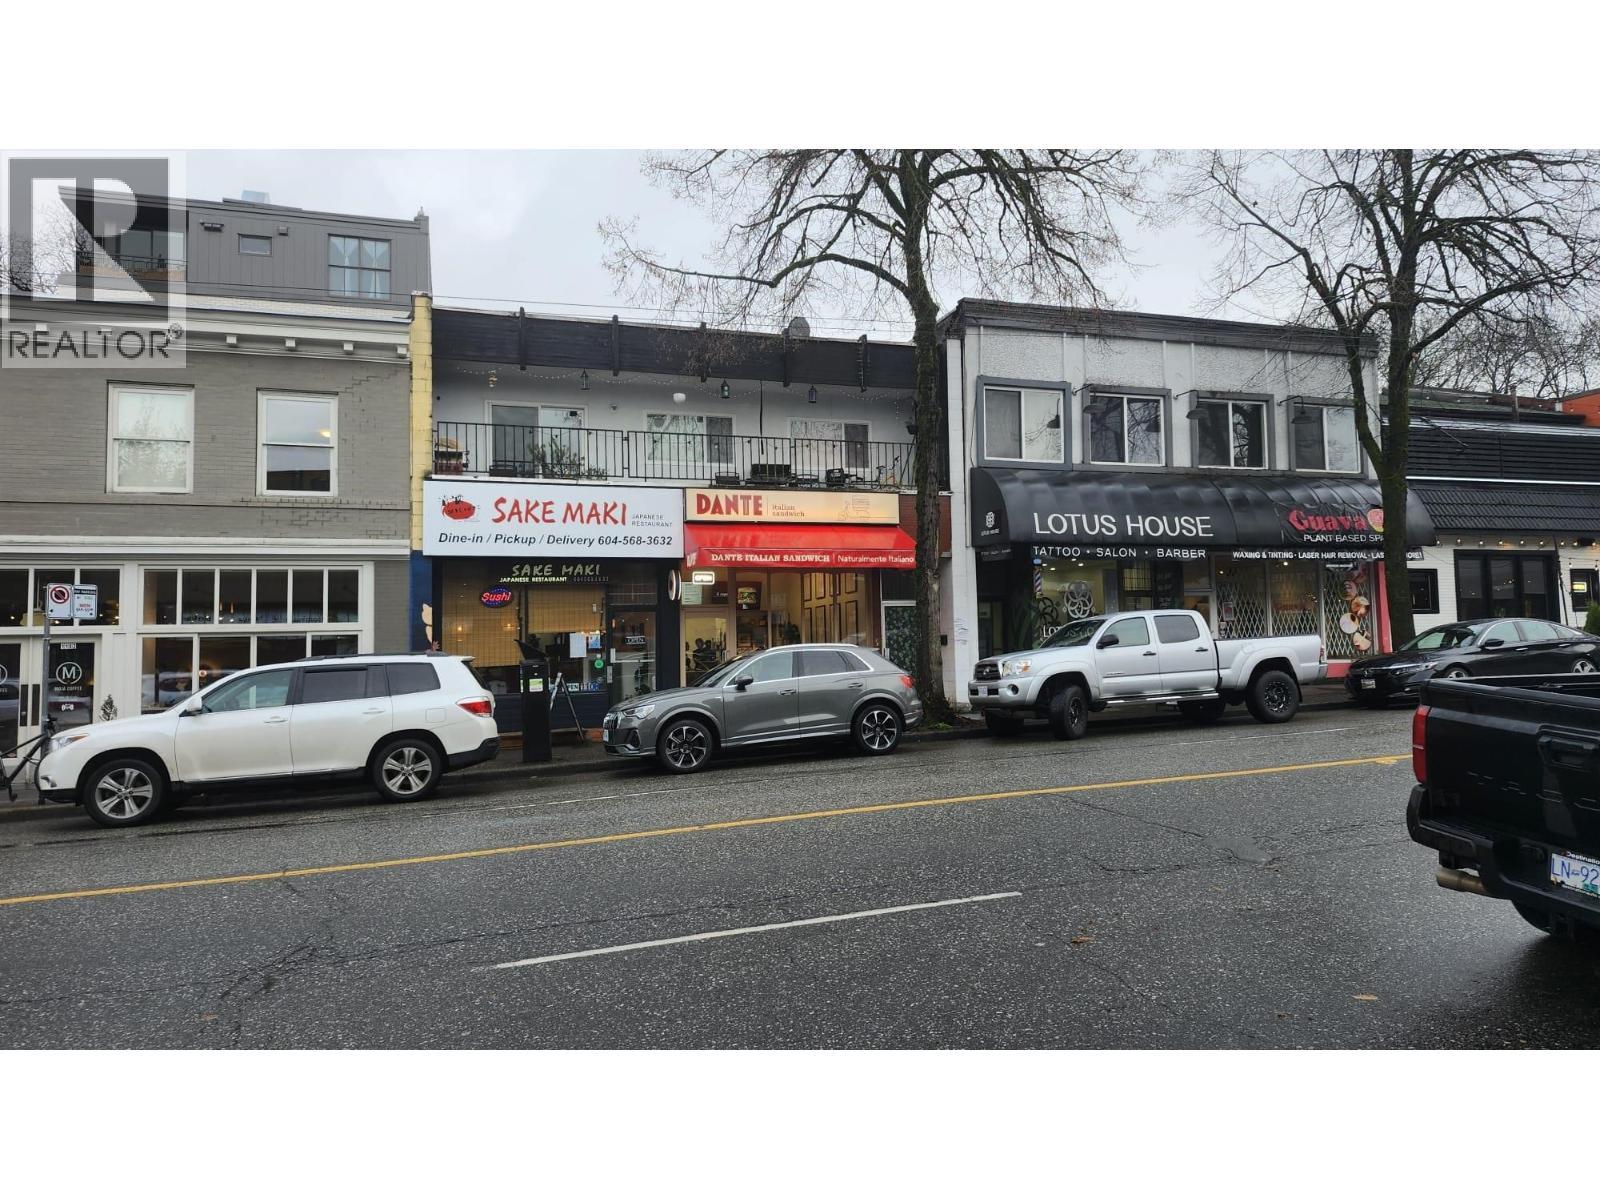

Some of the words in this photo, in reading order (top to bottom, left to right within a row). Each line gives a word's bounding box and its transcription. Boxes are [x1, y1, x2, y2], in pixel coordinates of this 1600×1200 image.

[492, 496, 556, 523] SAKE
[562, 502, 627, 526] MAKI
[696, 493, 763, 516] DANTE
[772, 503, 796, 511] italian
[1033, 512, 1117, 536] LOTUS
[1125, 514, 1214, 537] HOUSE
[1288, 509, 1367, 531] Guava
[438, 532, 483, 543] Dine-in
[494, 533, 536, 547] Pickup
[546, 534, 595, 547] Delivery
[597, 535, 673, 546] 604-568-3632
[1303, 534, 1333, 542] PLANT
[711, 553, 743, 562] DANTE
[745, 554, 780, 562] ITALIAN
[837, 555, 887, 563] Naturalmente
[888, 555, 915, 563] Italiano
[1033, 546, 1081, 557] TATTOO
[1096, 547, 1137, 558] SALON
[1156, 548, 1206, 559] BARBER
[1232, 551, 1261, 559] WAXING
[1268, 551, 1294, 559] TINTING
[1298, 551, 1320, 559] LASER
[512, 563, 553, 576] SAKE
[561, 563, 601, 576] MAKI
[481, 591, 512, 603] Sushi
[62, 665, 76, 680] M
